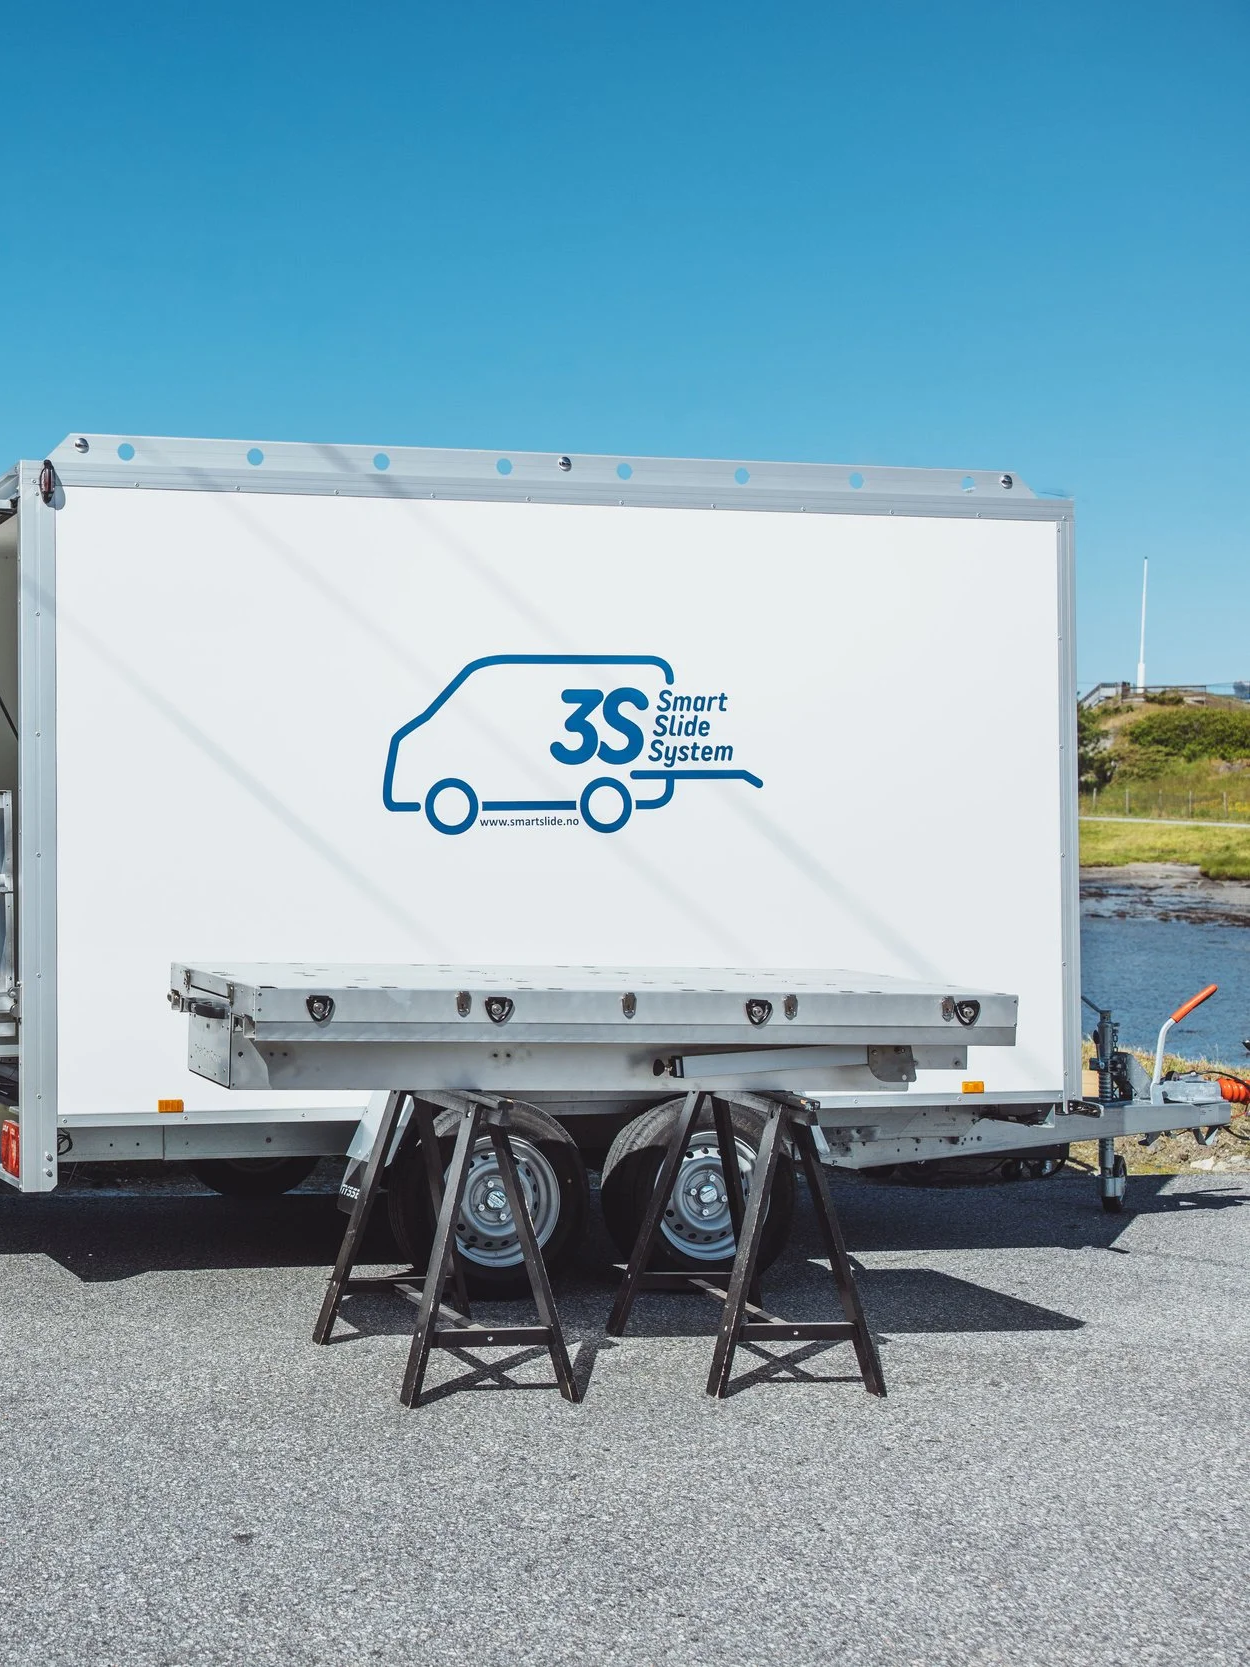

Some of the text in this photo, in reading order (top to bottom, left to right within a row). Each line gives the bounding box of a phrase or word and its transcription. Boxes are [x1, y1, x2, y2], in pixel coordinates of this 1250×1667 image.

[656, 689, 729, 713] Smart
[549, 687, 649, 766] 3S
[652, 714, 711, 738] Slide
[647, 739, 734, 768] System
[479, 816, 580, 828] www.smartslide.no
